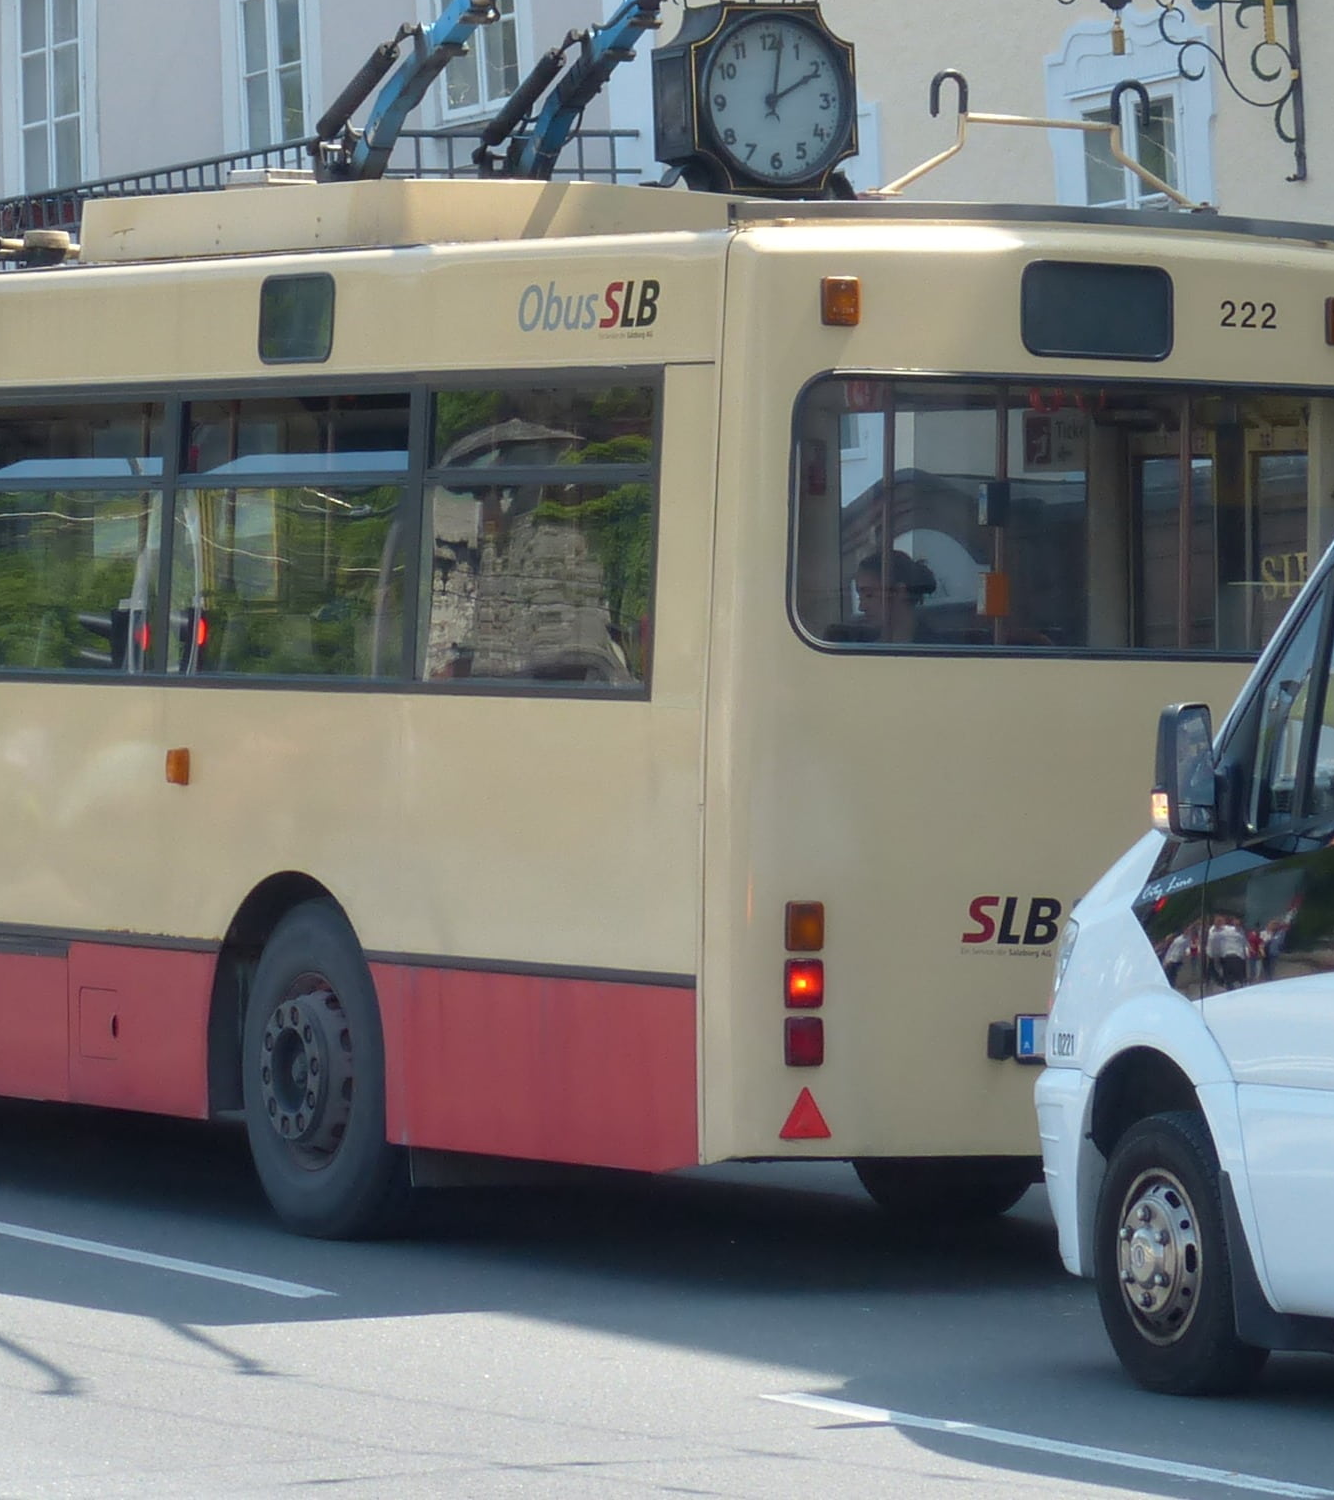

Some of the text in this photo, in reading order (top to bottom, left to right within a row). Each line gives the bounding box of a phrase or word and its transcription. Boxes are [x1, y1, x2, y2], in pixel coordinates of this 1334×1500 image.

[732, 42, 747, 60] 11
[793, 43, 800, 61] 1
[720, 62, 737, 81] 10
[714, 94, 727, 112] 9
[819, 93, 831, 110] 3
[723, 128, 737, 145] 8
[813, 123, 825, 142] 4
[745, 143, 758, 161] 7
[796, 142, 807, 160] 5
[770, 152, 783, 170] 6
[1220, 300, 1277, 330] 222
[961, 895, 1063, 946] SLB
